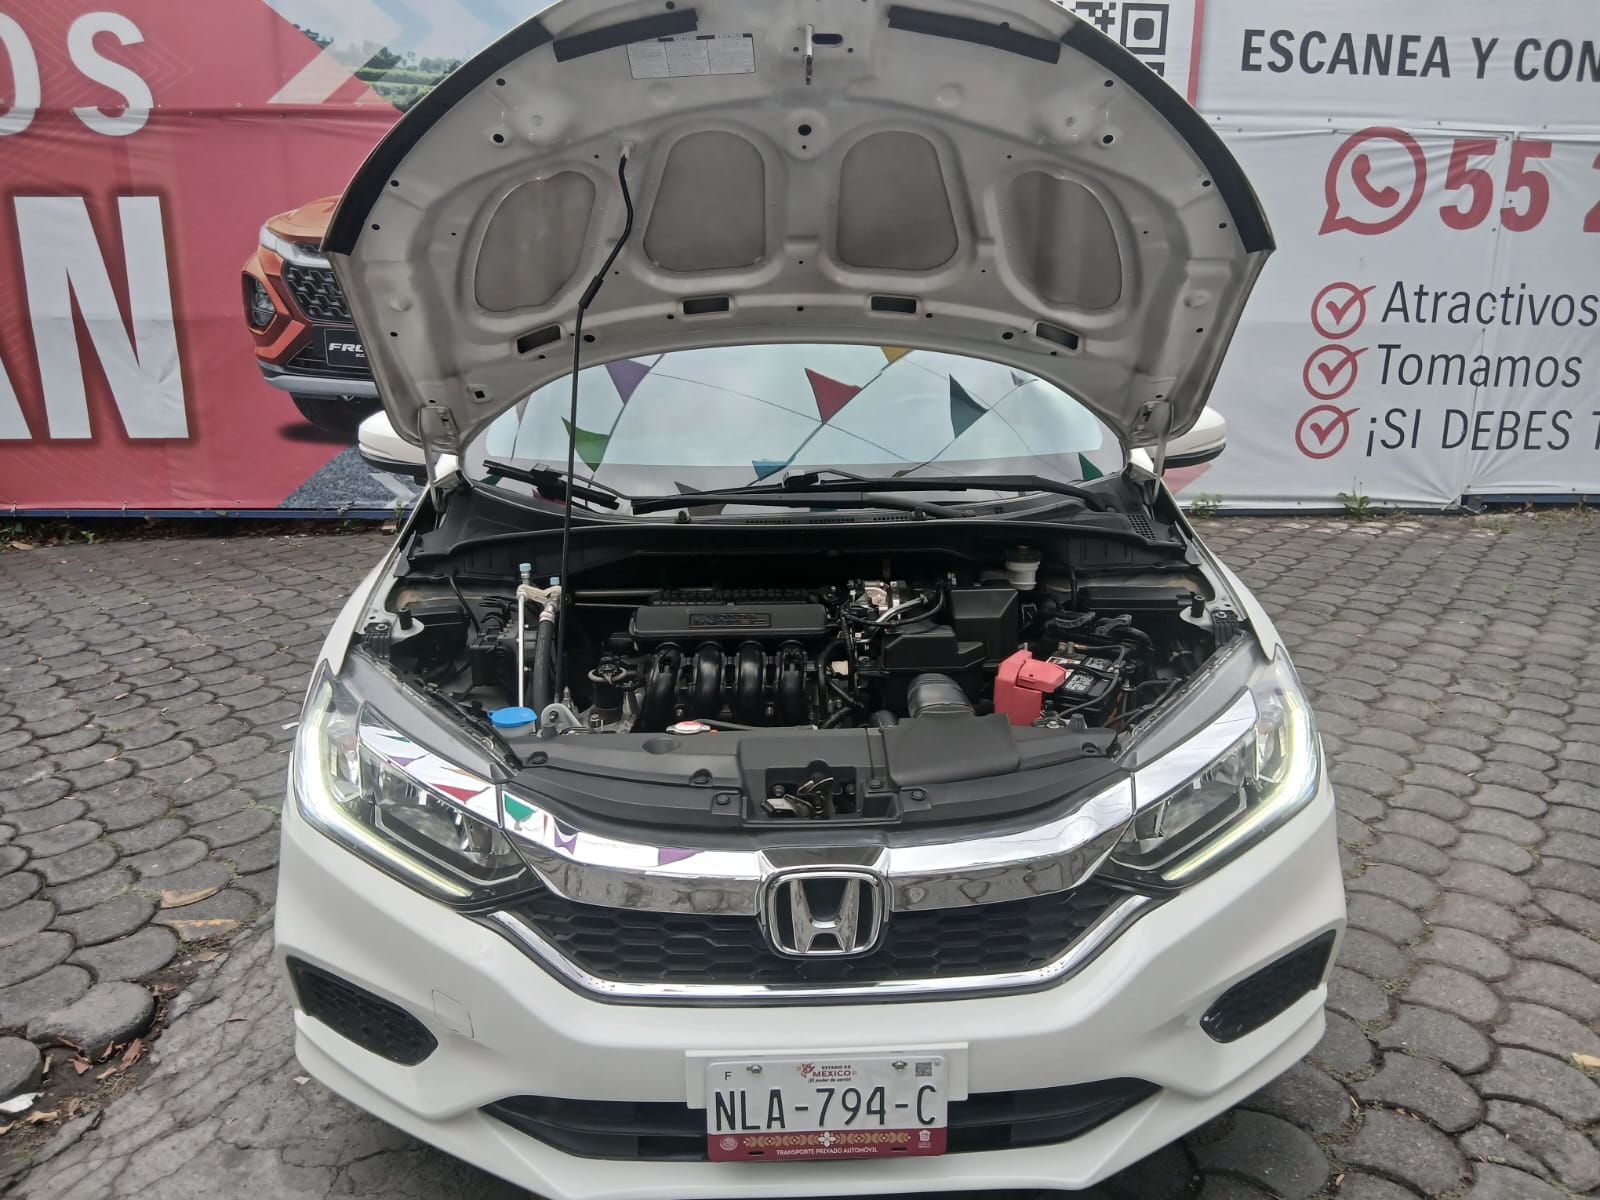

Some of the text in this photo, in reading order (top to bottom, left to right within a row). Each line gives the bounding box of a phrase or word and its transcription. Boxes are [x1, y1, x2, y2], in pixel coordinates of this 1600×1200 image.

[1241, 29, 1600, 82] ESCANEA Y CON
[1439, 139, 1552, 232] 55
[0, 196, 189, 439] N
[1381, 281, 1600, 327] Atractivos
[1378, 344, 1582, 388] Tomamos
[1366, 408, 1421, 456] ¡SI
[1441, 409, 1572, 450] DEBES
[724, 1071, 732, 1080] F
[715, 1085, 936, 1131] NLA-794-C
